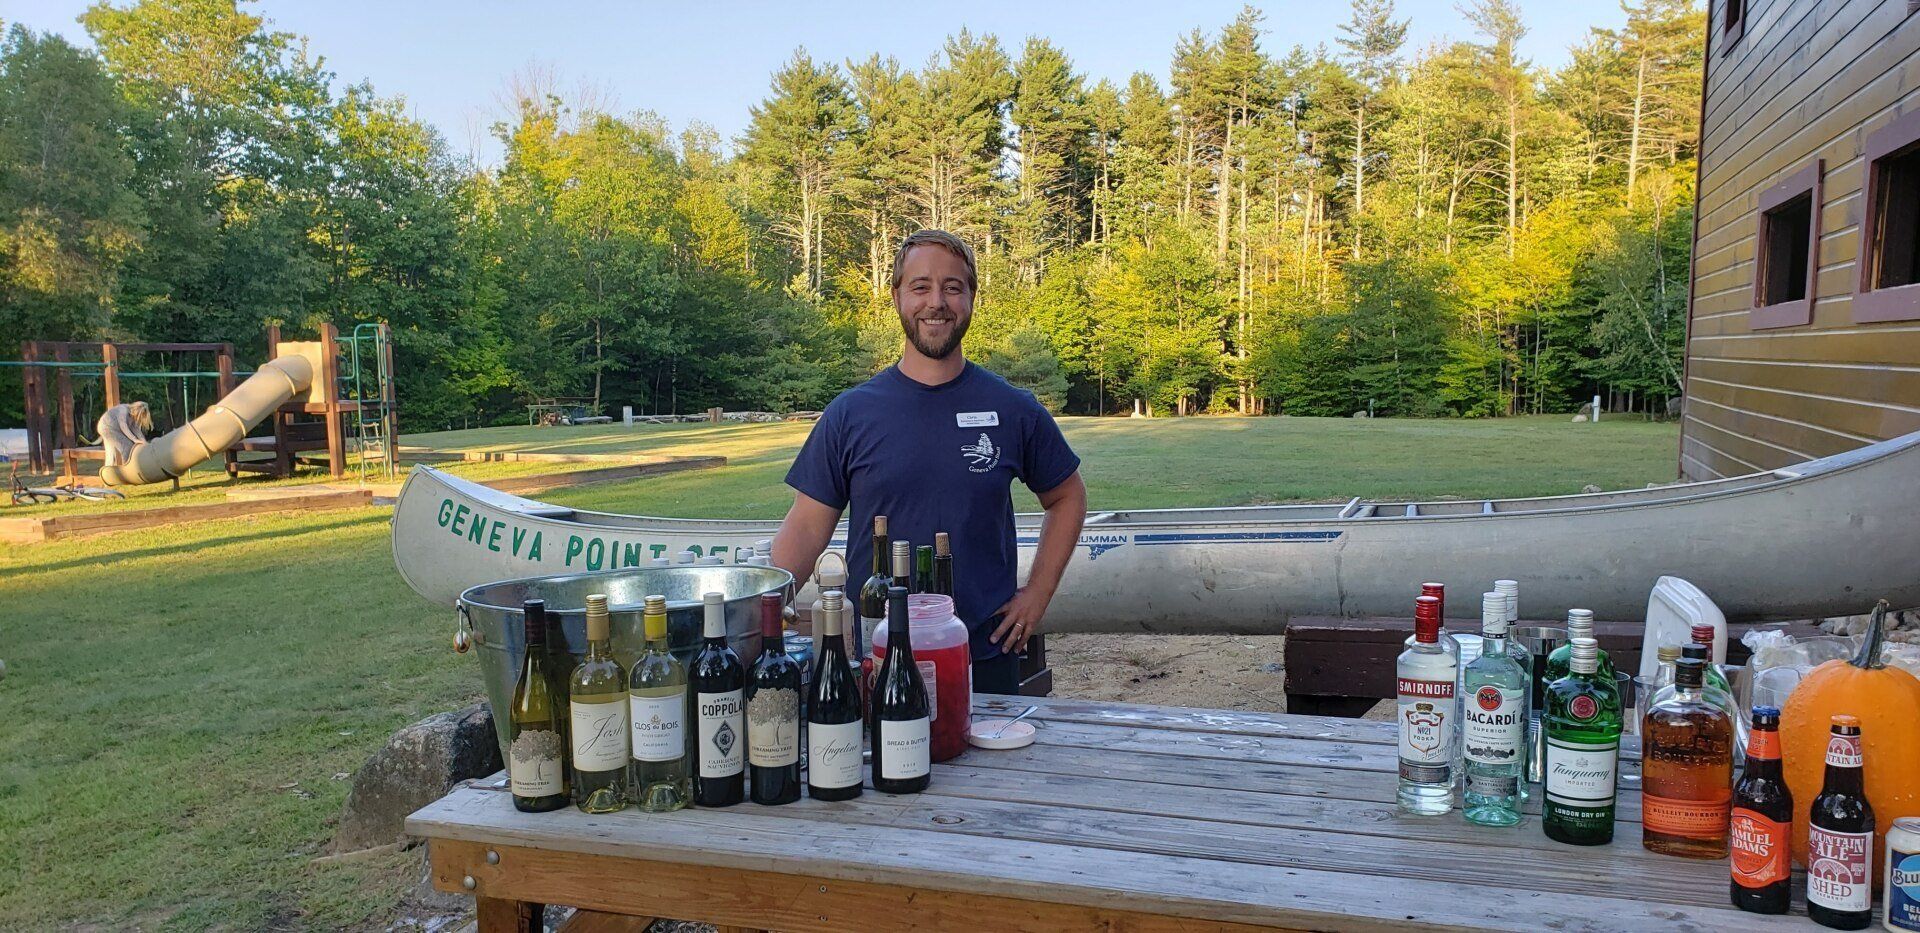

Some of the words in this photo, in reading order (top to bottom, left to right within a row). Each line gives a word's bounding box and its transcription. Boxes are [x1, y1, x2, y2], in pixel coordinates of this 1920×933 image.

[968, 465, 989, 473] Geneva
[437, 498, 543, 562] GENEVA
[565, 534, 667, 571] POINT
[1078, 535, 1127, 543] UMMAN
[1399, 680, 1452, 696] SMIRNOFF
[702, 699, 743, 716] COPPOLA
[634, 721, 651, 731] CLOS
[661, 720, 679, 731] BOIS
[1466, 709, 1517, 726] BACARDÍ
[578, 713, 626, 756] Josh
[1473, 726, 1507, 734] SUPERIOR
[910, 736, 927, 745] BUTTER
[1553, 762, 1610, 781] Tanqueray
[1554, 806, 1580, 818] LONDON
[1581, 811, 1594, 819] DRY
[1653, 807, 1682, 817] BULLEIT
[1731, 836, 1769, 857] ADAMS
[1809, 828, 1865, 853] MOUNTAIN
[1816, 841, 1849, 861] ALE
[1812, 877, 1852, 897] SHED
[1816, 891, 1844, 901] BREWERY
